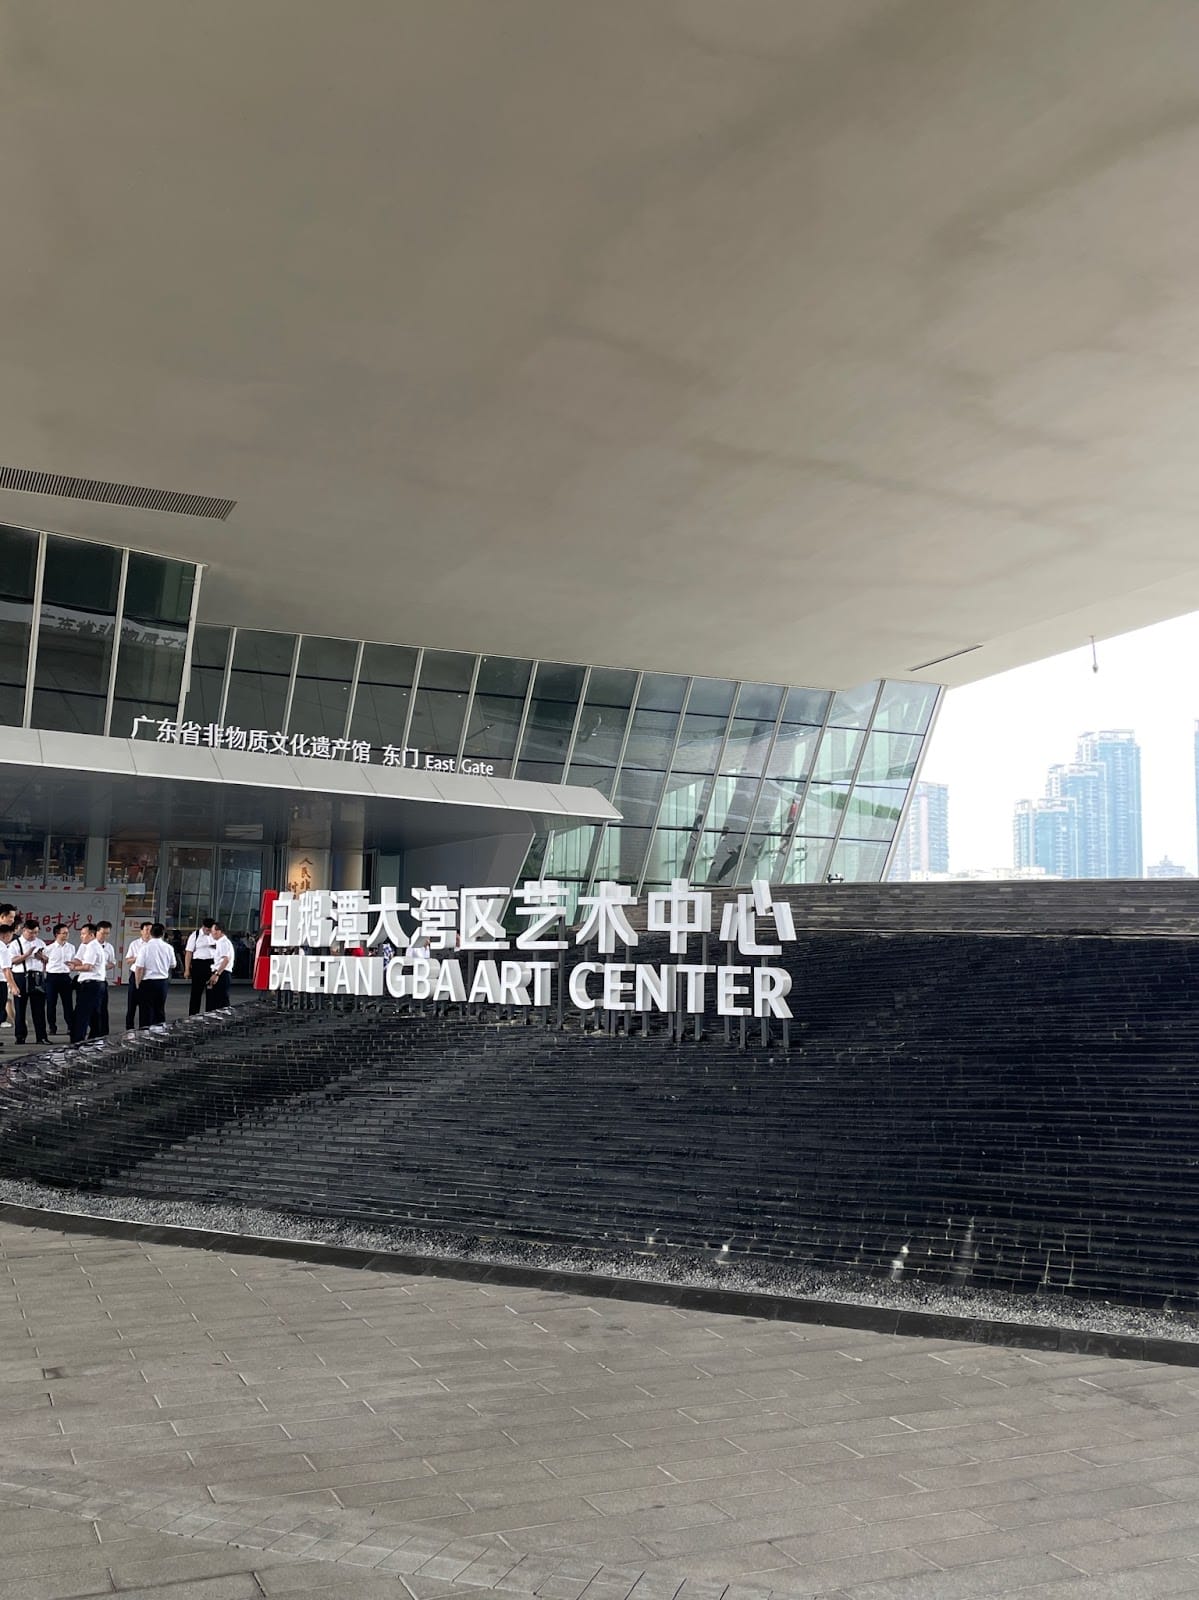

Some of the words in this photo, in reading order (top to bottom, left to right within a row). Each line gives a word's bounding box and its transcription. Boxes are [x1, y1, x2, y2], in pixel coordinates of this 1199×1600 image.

[131, 715, 371, 763] 广东省非物质文化遗产馆
[382, 744, 419, 768] 东门
[425, 755, 456, 772] East
[461, 759, 494, 776] Gate
[270, 878, 797, 956] 白鹅潭大湾区艺术中心
[268, 955, 384, 996] BAIETAN
[385, 957, 467, 1002] GBA
[468, 960, 559, 1006] ART
[568, 962, 794, 1019] CENTER
